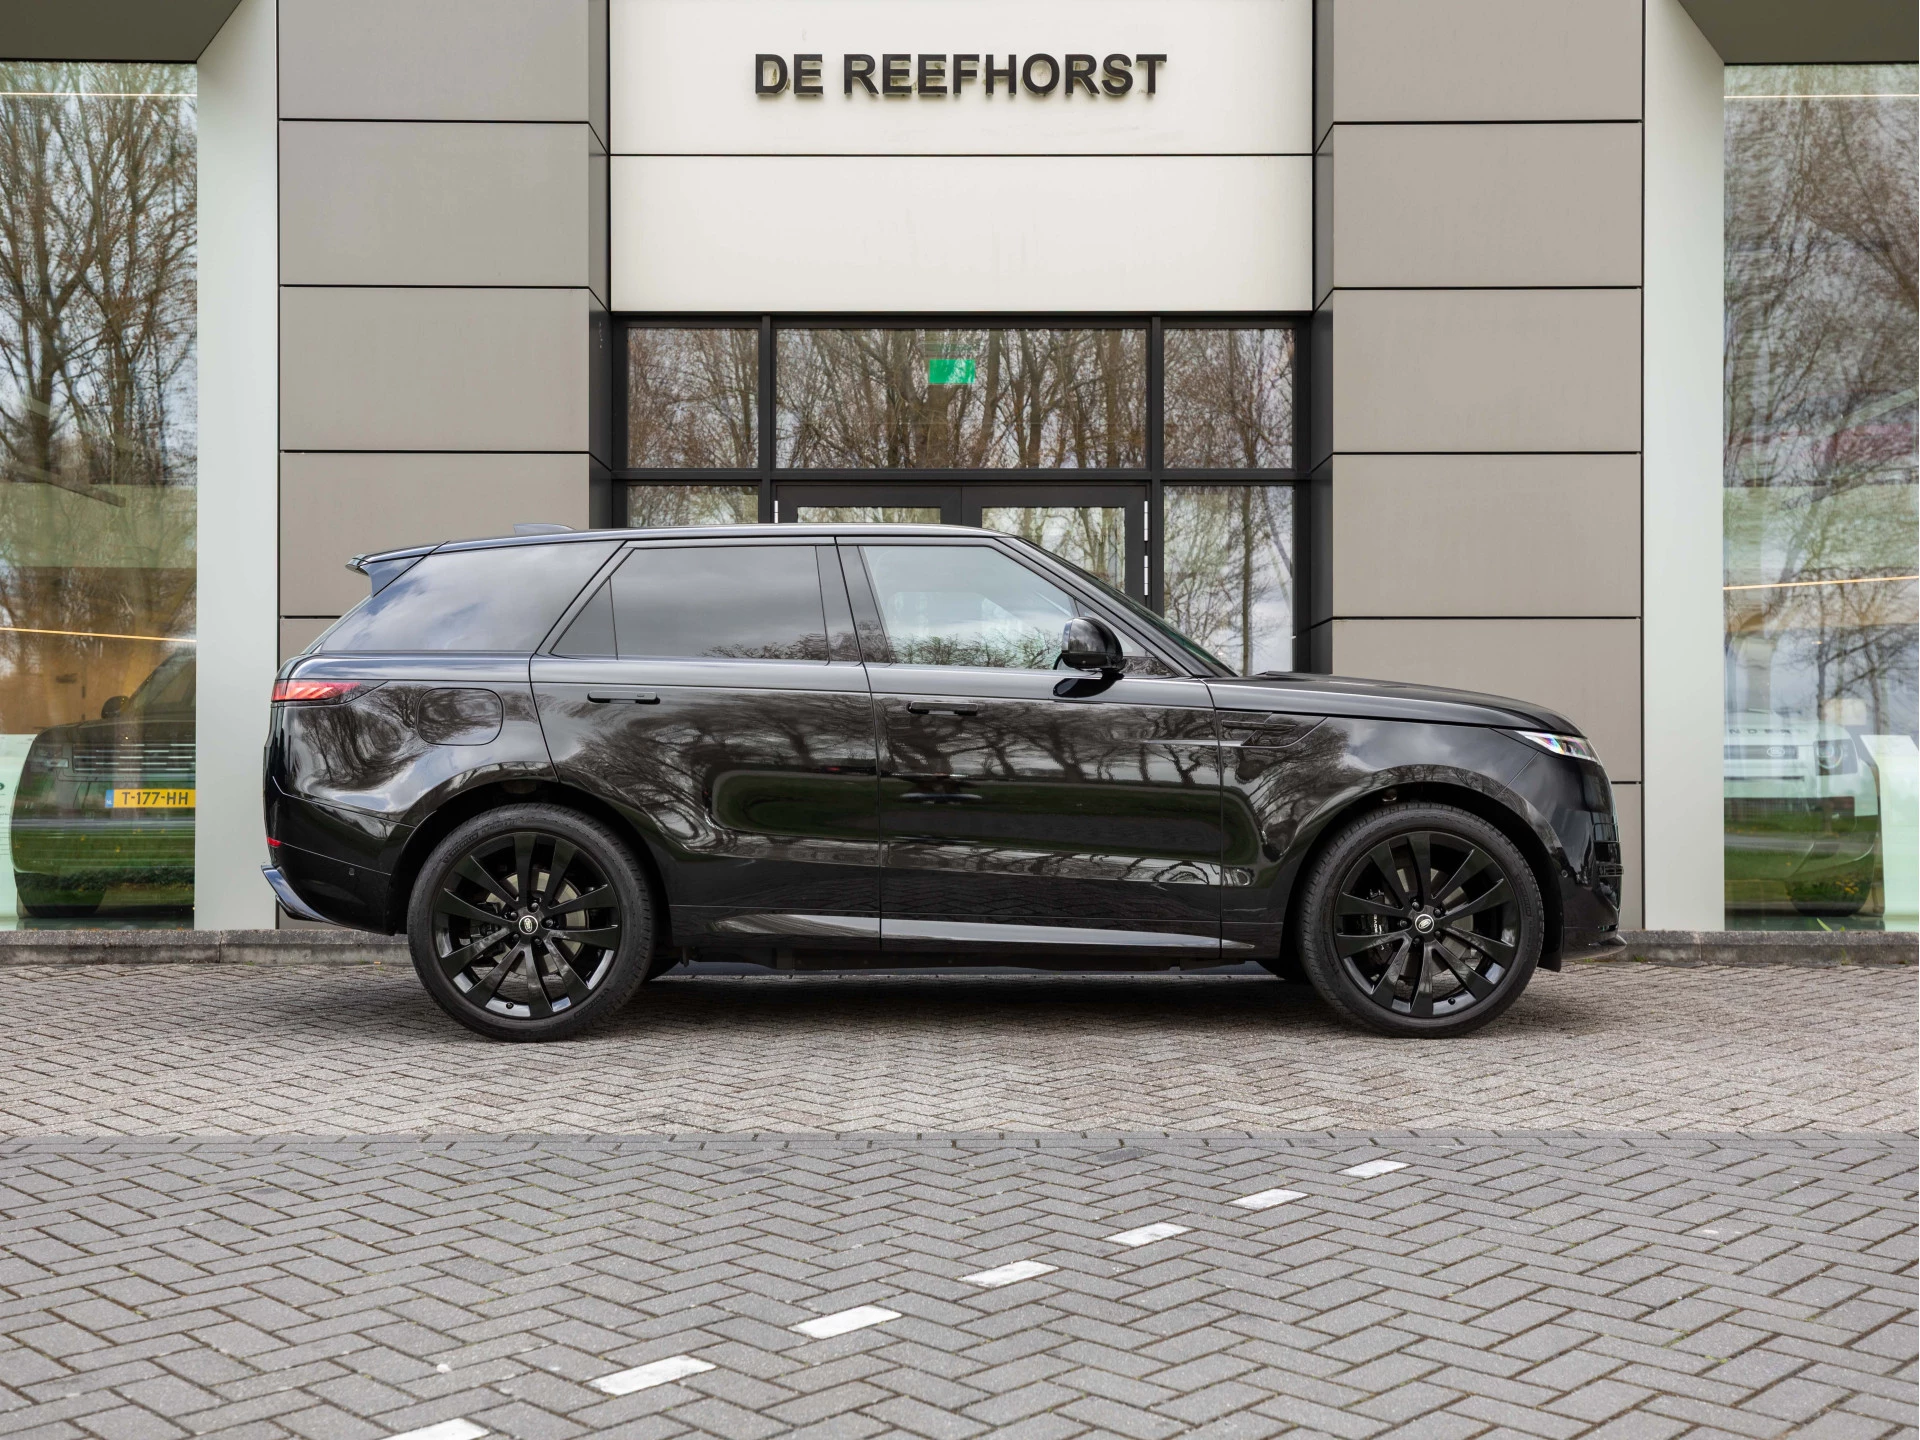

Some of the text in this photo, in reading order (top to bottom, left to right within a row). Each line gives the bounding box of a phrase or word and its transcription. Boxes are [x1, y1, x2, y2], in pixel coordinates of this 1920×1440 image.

[755, 53, 1168, 96] DE REEFHORST
[121, 791, 189, 805] T-177-HH
